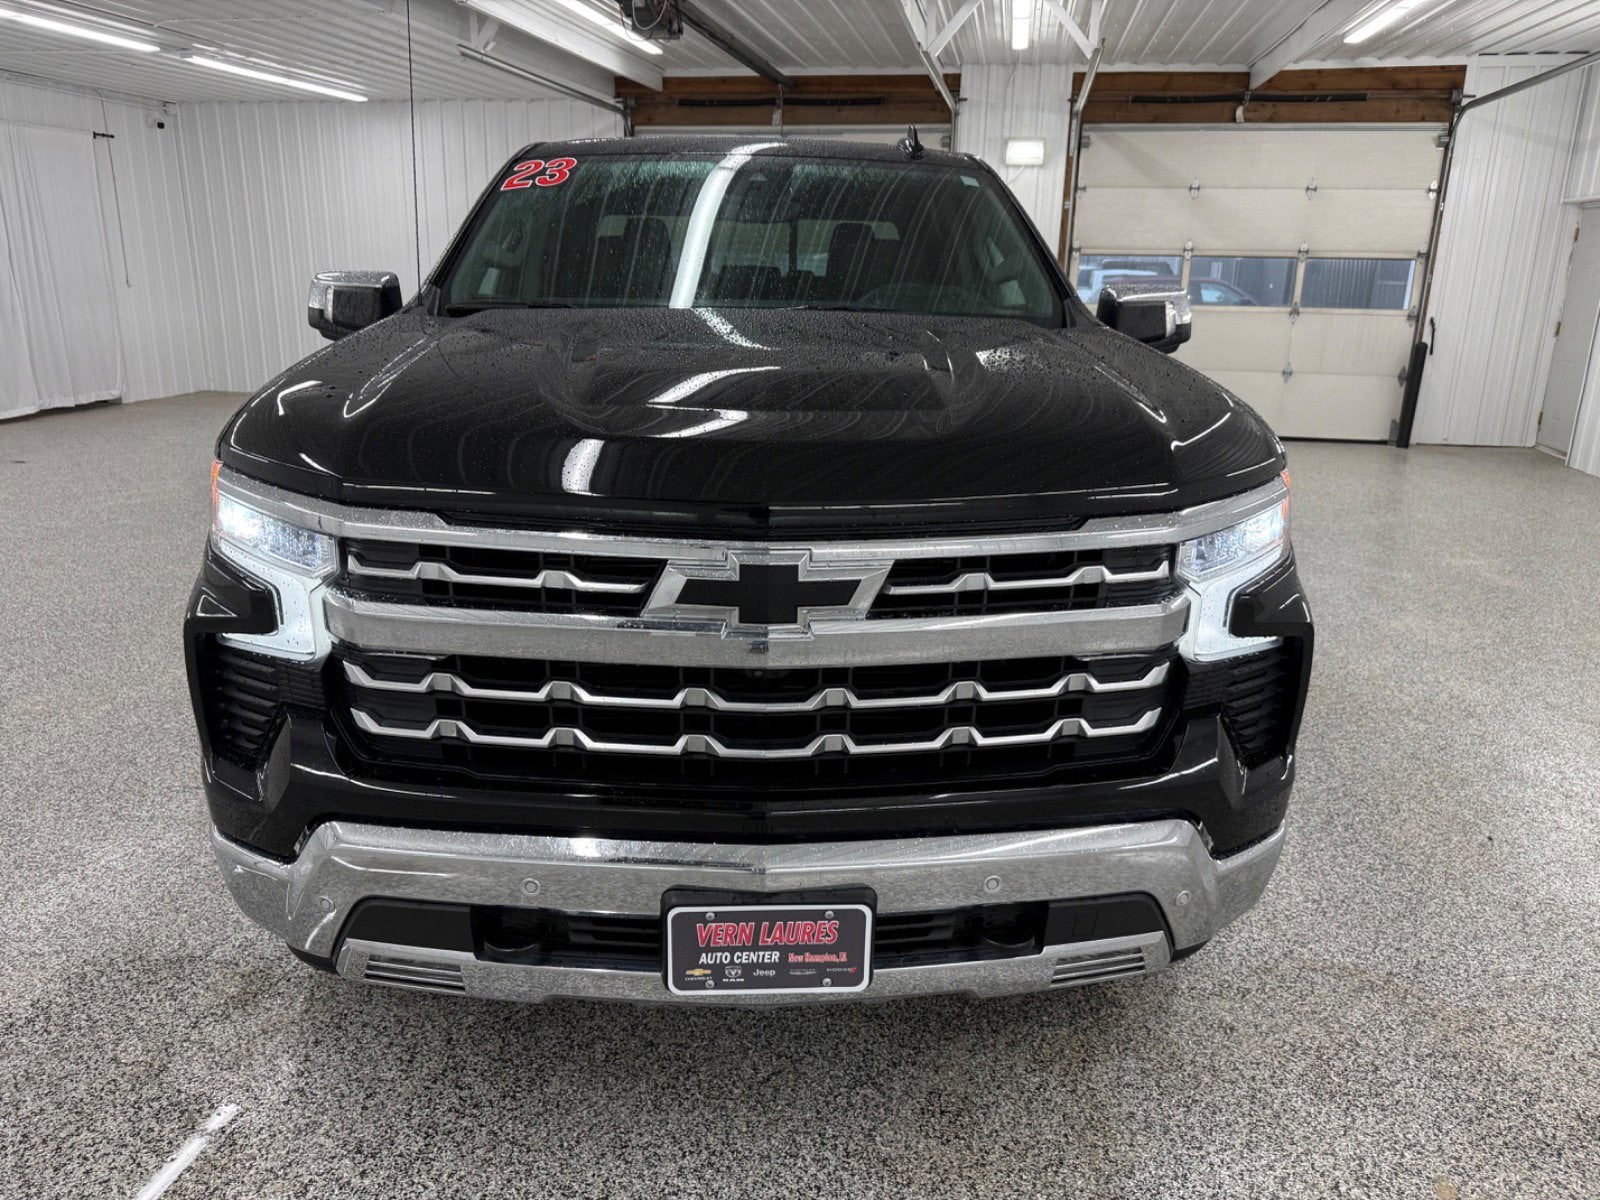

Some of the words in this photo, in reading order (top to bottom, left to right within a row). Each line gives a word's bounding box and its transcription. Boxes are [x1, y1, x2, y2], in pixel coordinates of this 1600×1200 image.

[500, 157, 577, 191] 23
[696, 922, 755, 948] VERN
[758, 920, 840, 946] LAURES
[698, 952, 731, 965] AUTO
[733, 951, 780, 964] CENTER
[788, 952, 804, 963] New
[752, 968, 776, 977] Jeep
